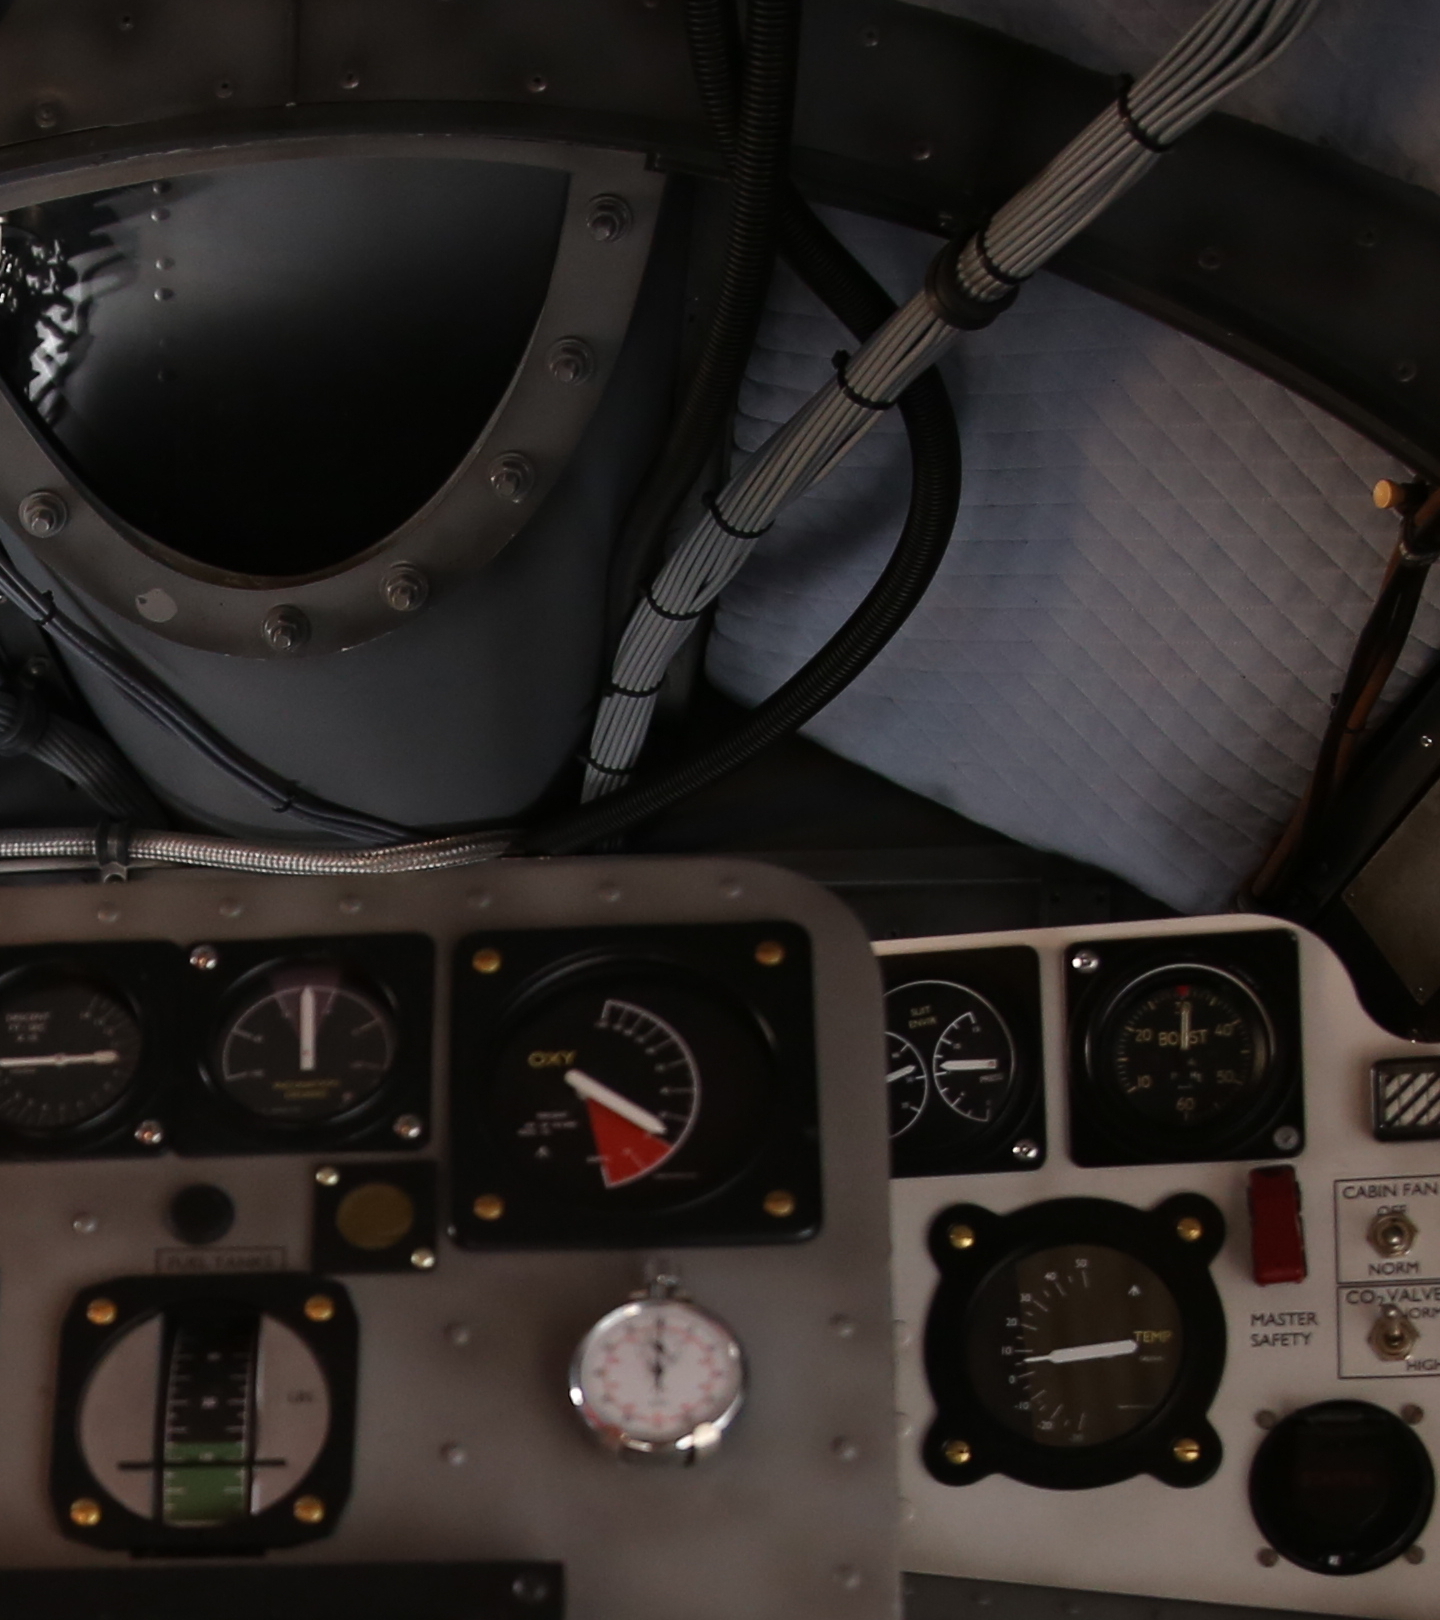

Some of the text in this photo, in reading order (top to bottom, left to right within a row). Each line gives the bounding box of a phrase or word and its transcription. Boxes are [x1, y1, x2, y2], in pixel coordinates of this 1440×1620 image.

[1135, 1028, 1152, 1042] 20
[1158, 1030, 1208, 1047] BOST
[528, 1049, 576, 1069] OXY
[1342, 1180, 1439, 1200] CABIN FAN
[1377, 1204, 1408, 1218] OFF
[1368, 1261, 1420, 1276] NORM
[1251, 1312, 1318, 1327] MASTER
[1134, 1330, 1171, 1343] TEMP
[1250, 1331, 1312, 1348] SAFETY
